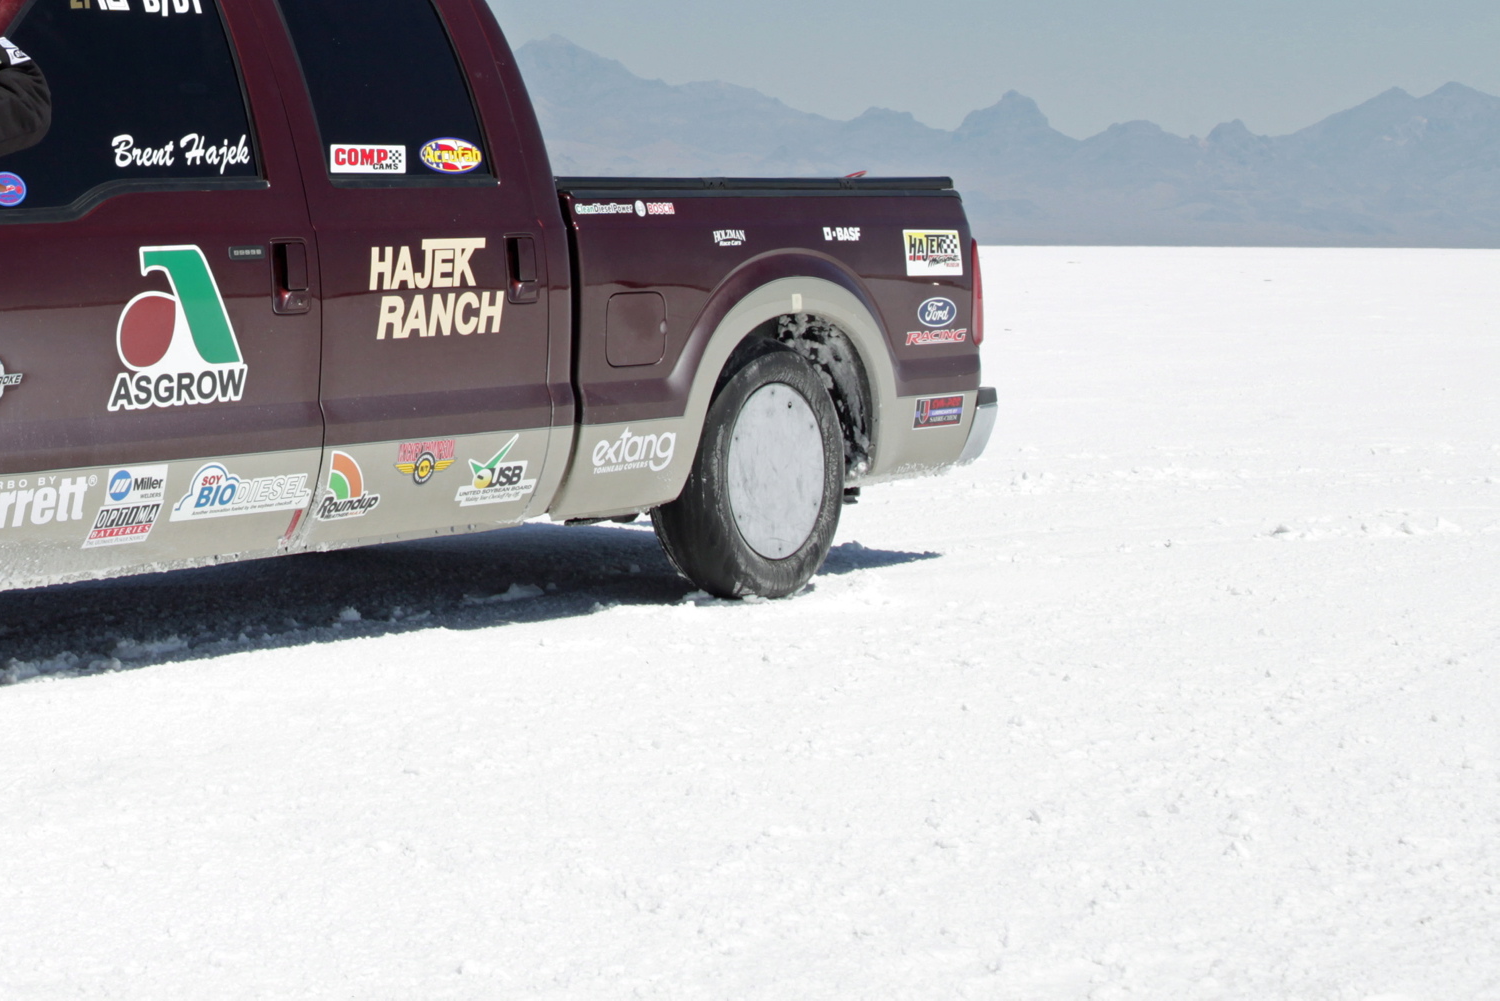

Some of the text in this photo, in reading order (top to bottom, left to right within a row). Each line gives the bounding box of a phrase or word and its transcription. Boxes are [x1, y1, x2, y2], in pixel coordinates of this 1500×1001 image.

[111, 133, 250, 175] Brent Hajek
[334, 148, 388, 166] COMP
[423, 146, 482, 164] Accufab
[372, 162, 399, 170] CAMS
[646, 202, 675, 214] BOSCH
[713, 229, 746, 243] HOLZMAN
[835, 227, 861, 241] BASF
[908, 234, 946, 261] HAJEK
[369, 238, 486, 290] HAJEK
[376, 291, 504, 340] RANCH
[924, 301, 949, 321] Ford
[905, 328, 967, 345] RACING
[111, 368, 245, 407] ASGROW
[592, 426, 676, 471] extang
[486, 465, 523, 488] USB
[593, 461, 649, 474] TONNEAU COVERS
[38, 476, 56, 486] BY
[132, 477, 164, 491] Miller
[201, 475, 222, 486] SOY
[316, 493, 379, 518] Roundup
[94, 503, 161, 529] OPTIMA
[90, 524, 151, 539] BATTERIES
